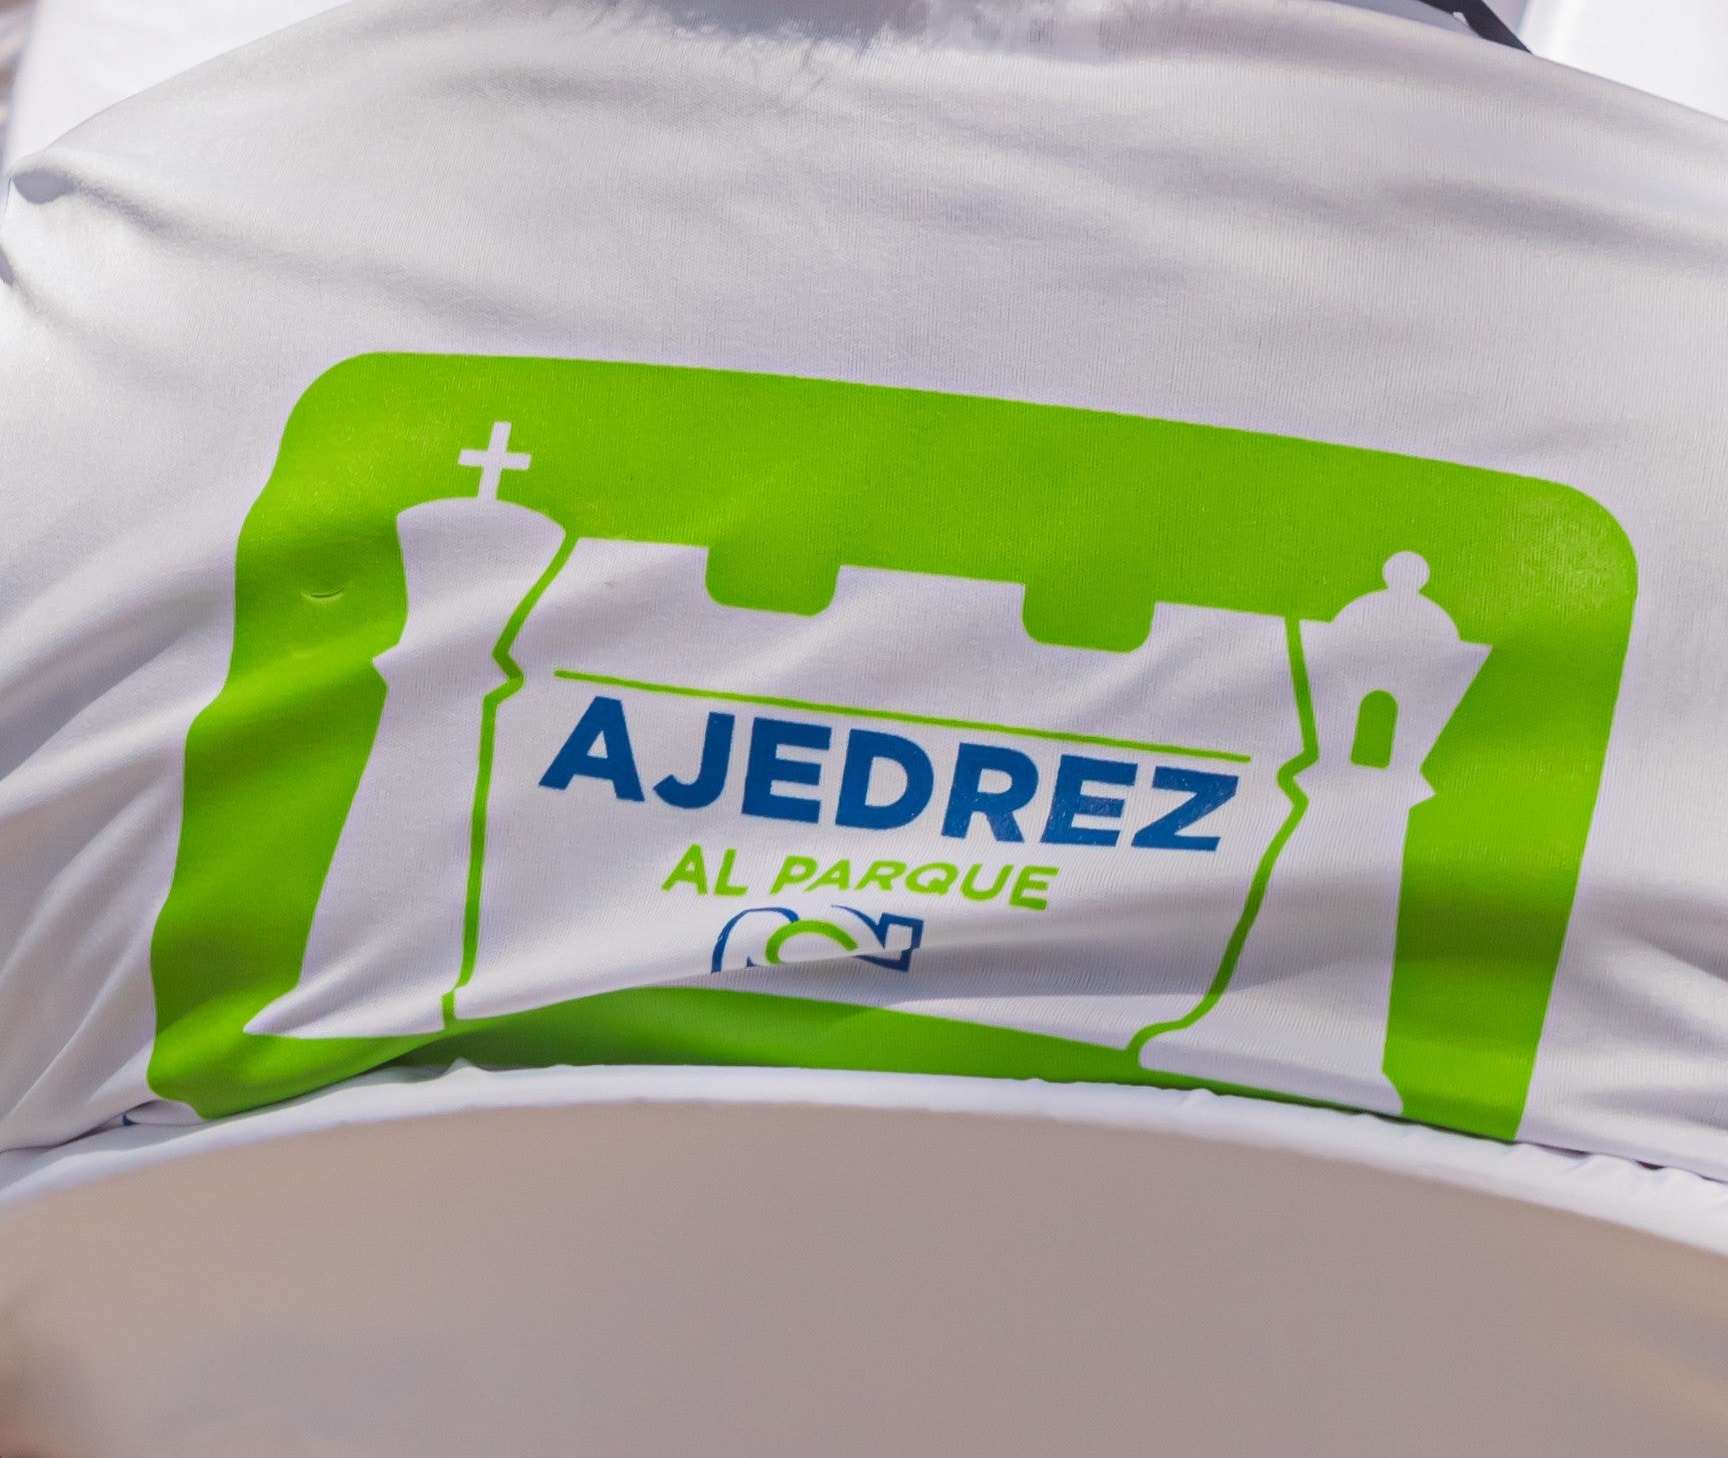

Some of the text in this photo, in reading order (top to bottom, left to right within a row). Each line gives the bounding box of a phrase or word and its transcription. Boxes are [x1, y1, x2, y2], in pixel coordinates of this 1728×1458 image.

[539, 696, 1240, 852] AJEDREZ
[662, 844, 1059, 911] AL PARQUE
